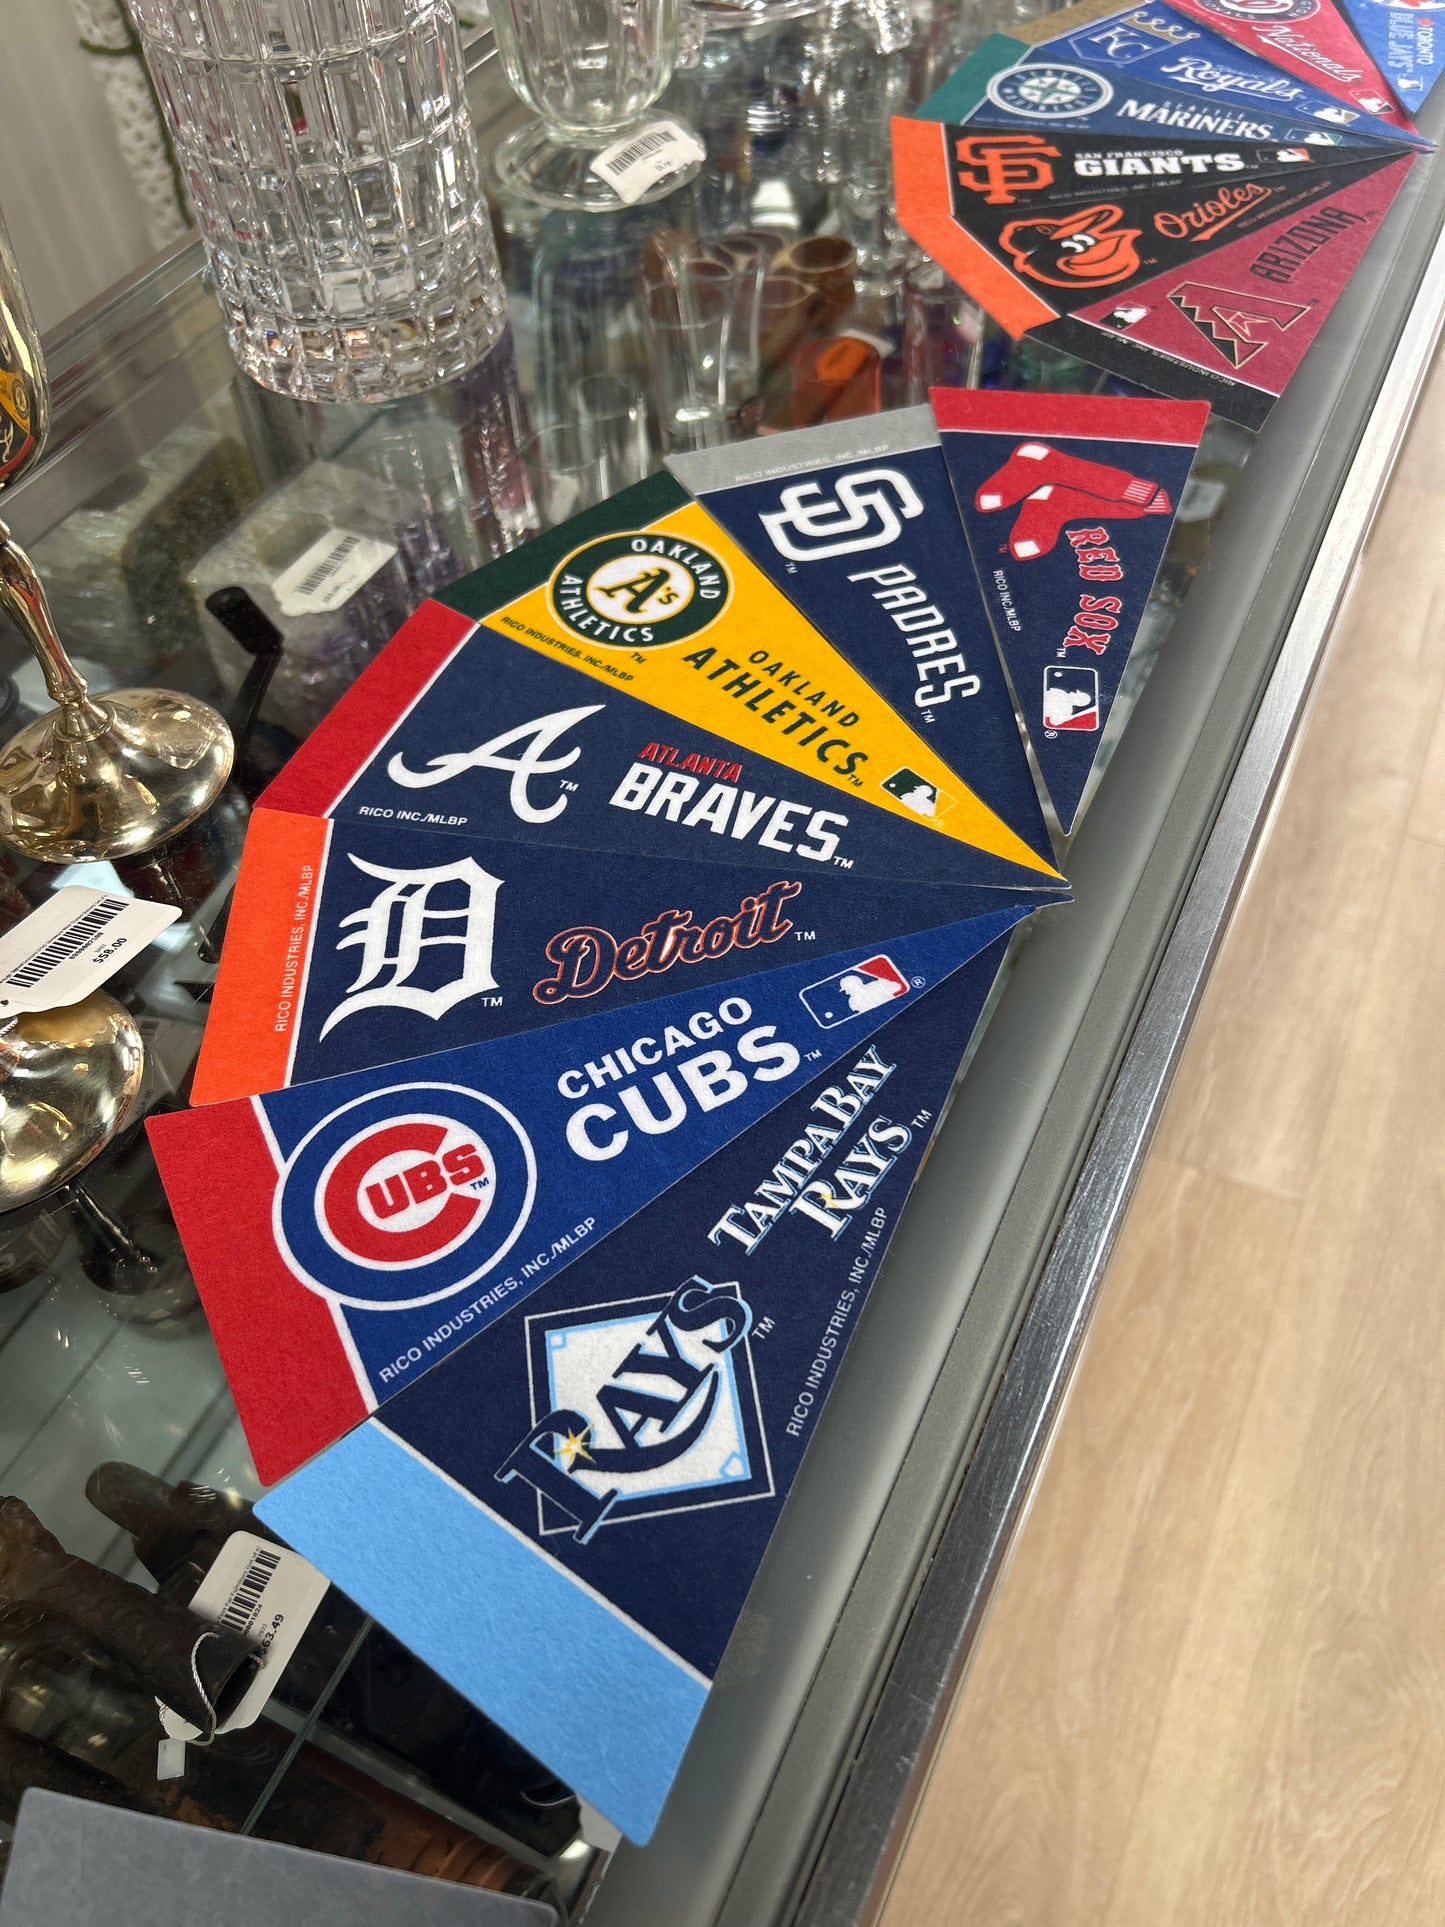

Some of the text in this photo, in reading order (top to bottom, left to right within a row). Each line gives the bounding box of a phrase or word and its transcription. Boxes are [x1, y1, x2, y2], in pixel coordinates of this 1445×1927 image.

[1088, 26, 1149, 59] KC
[1251, 24, 1365, 83] Nationals
[1388, 12, 1414, 68] BLUE JAYS
[1416, 27, 1434, 65] TORONTO
[1160, 56, 1305, 102] Royals
[1116, 99, 1273, 141] MARINERS
[955, 135, 1062, 204] SF
[1074, 149, 1184, 160] SAN FRANCISCO
[1074, 153, 1245, 176] GIANTS
[1153, 182, 1273, 242] Orioles
[1250, 206, 1367, 285] ARIZONA
[734, 471, 762, 482] RICO
[758, 467, 924, 562] SD
[631, 539, 721, 600] OAKLAND
[784, 562, 798, 575] TM
[993, 570, 1008, 592] RICO
[1065, 527, 1123, 582] RED
[559, 573, 655, 643] ATHLETICS
[593, 566, 680, 614] A's
[500, 616, 525, 632] RICO
[846, 563, 981, 724] PADRES TM
[1062, 594, 1122, 656] SOX
[629, 651, 646, 665] TM
[682, 647, 868, 776] ATHLETICS
[748, 650, 860, 727] OAKLAND
[387, 704, 607, 824] A
[559, 779, 579, 793] TM
[638, 741, 743, 784] ATLANTA
[358, 805, 395, 820] RICO
[609, 761, 854, 870] BRAVES TM
[92, 937, 128, 964] $58.00
[319, 851, 505, 1043] D
[532, 880, 816, 1006] Detroit TM
[274, 1000, 290, 1032] RICO
[481, 996, 503, 1008] TM
[556, 996, 754, 1101] CHICAGO
[565, 1025, 823, 1163] CUBS TM
[707, 1044, 897, 1256] TAMPA BAY
[789, 1108, 931, 1242] RAYS TM
[468, 1178, 490, 1192] TM
[378, 1350, 421, 1384] RICO
[520, 1217, 597, 1280] INC./MLBP
[752, 1316, 776, 1340] TM
[786, 1391, 812, 1438] RICO
[846, 1207, 889, 1292] INC./MLBP
[493, 1274, 753, 1546] RAYS
